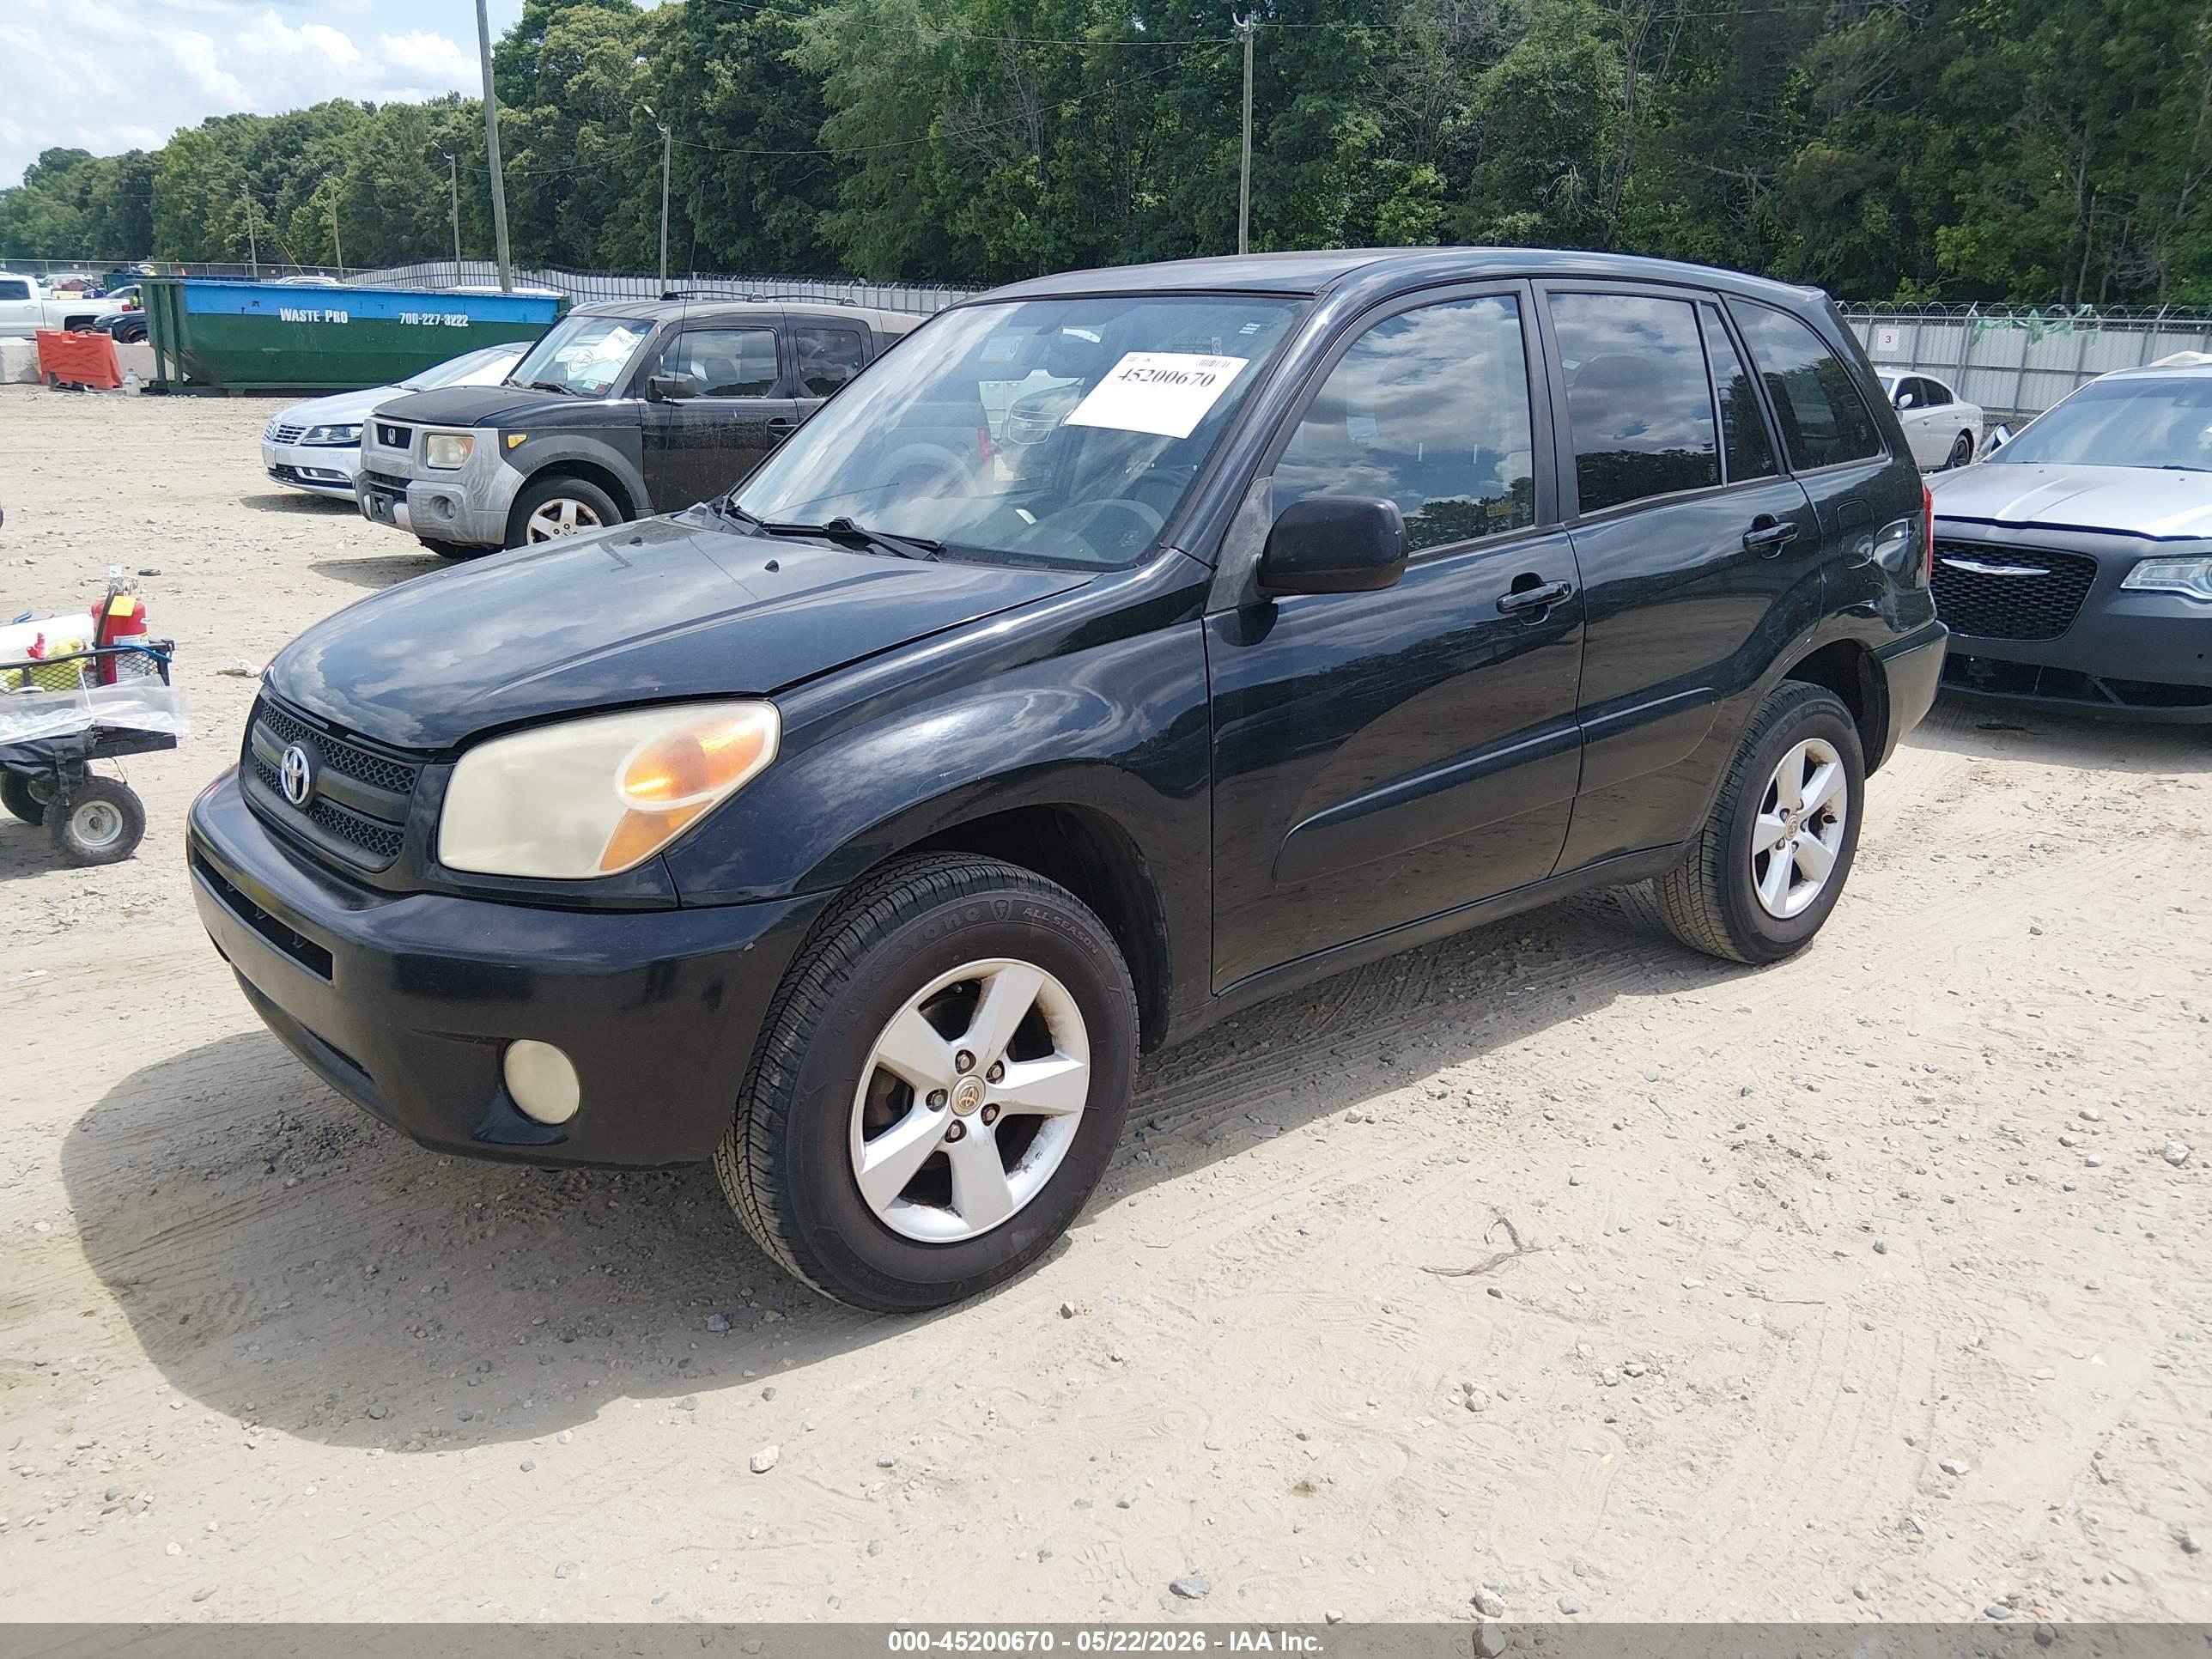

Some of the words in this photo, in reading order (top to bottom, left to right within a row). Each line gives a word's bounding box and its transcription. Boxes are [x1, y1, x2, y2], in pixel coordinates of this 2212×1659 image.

[279, 308, 320, 323] WASTE
[325, 309, 349, 324] PRO
[1885, 335, 1892, 343] 3
[1117, 368, 1217, 387] 45200670
[1022, 907, 1049, 921] ALL
[1052, 916, 1099, 954] SEASON
